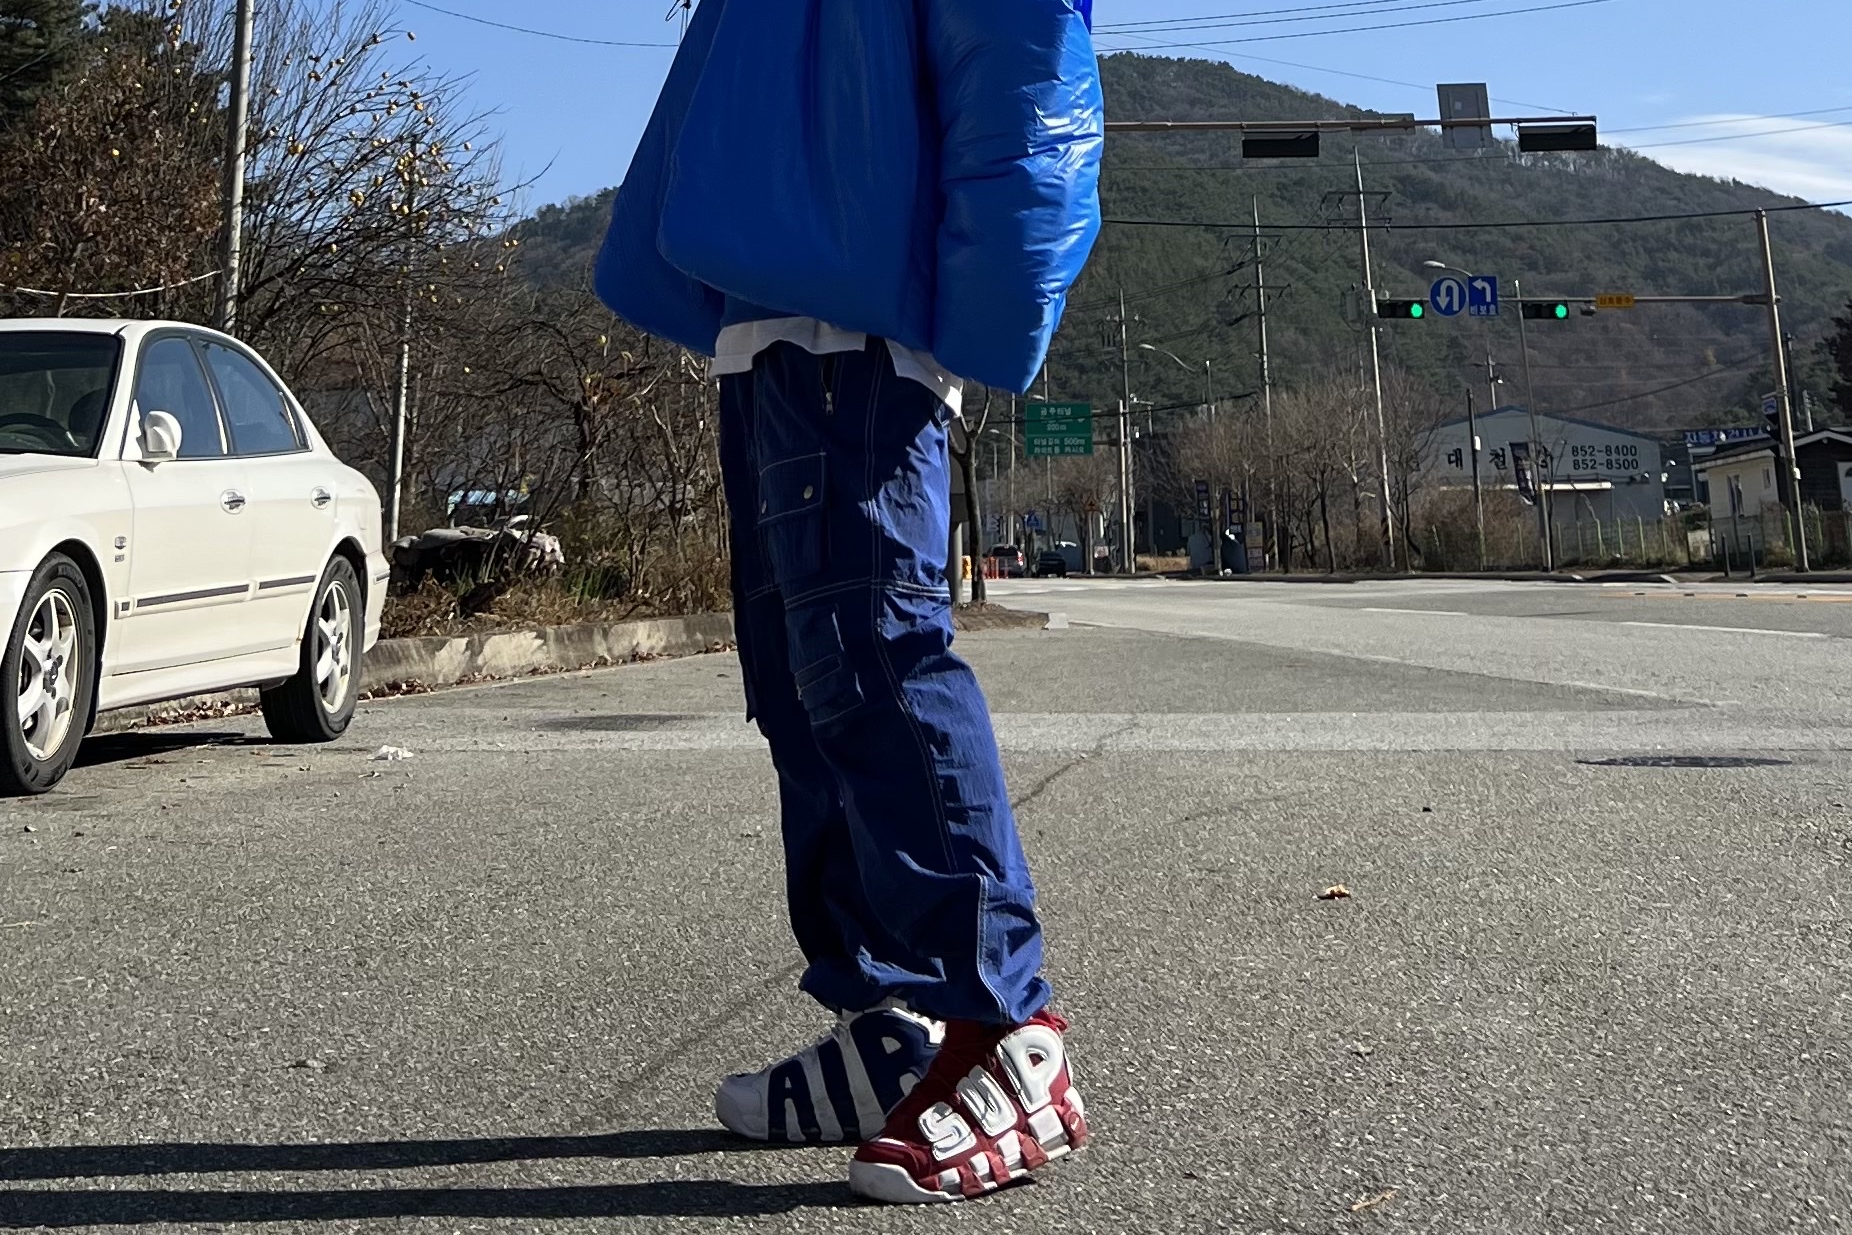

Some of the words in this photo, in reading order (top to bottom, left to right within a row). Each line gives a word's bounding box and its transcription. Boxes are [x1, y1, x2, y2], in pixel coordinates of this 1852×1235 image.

[1470, 303, 1497, 316] 비보호
[1571, 444, 1638, 457] 852-8400
[1572, 458, 1639, 470] 852-8500
[767, 1010, 934, 1141] AIR
[917, 1024, 1066, 1162] SUP
